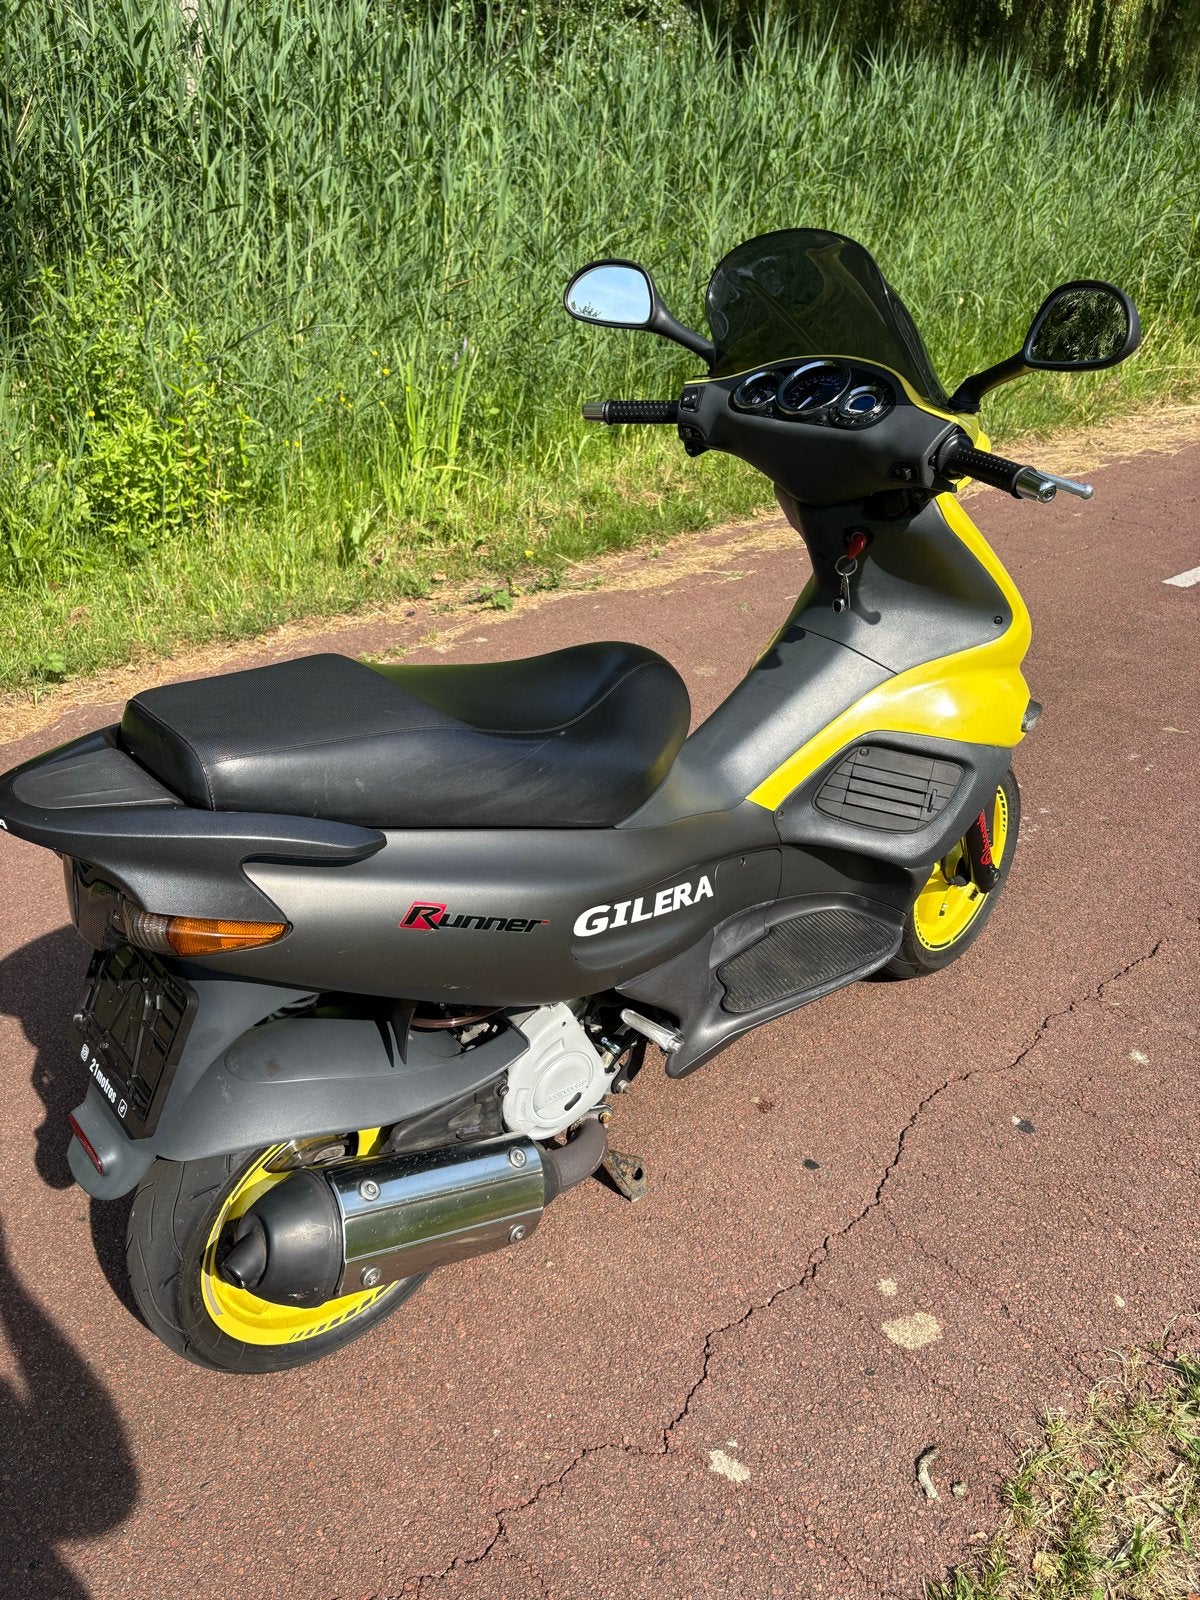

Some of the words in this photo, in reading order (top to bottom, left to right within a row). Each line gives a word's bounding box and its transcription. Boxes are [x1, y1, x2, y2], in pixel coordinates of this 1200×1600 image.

[402, 904, 546, 933] Runner
[573, 875, 714, 937] GILERA
[89, 1057, 117, 1104] 21motros
